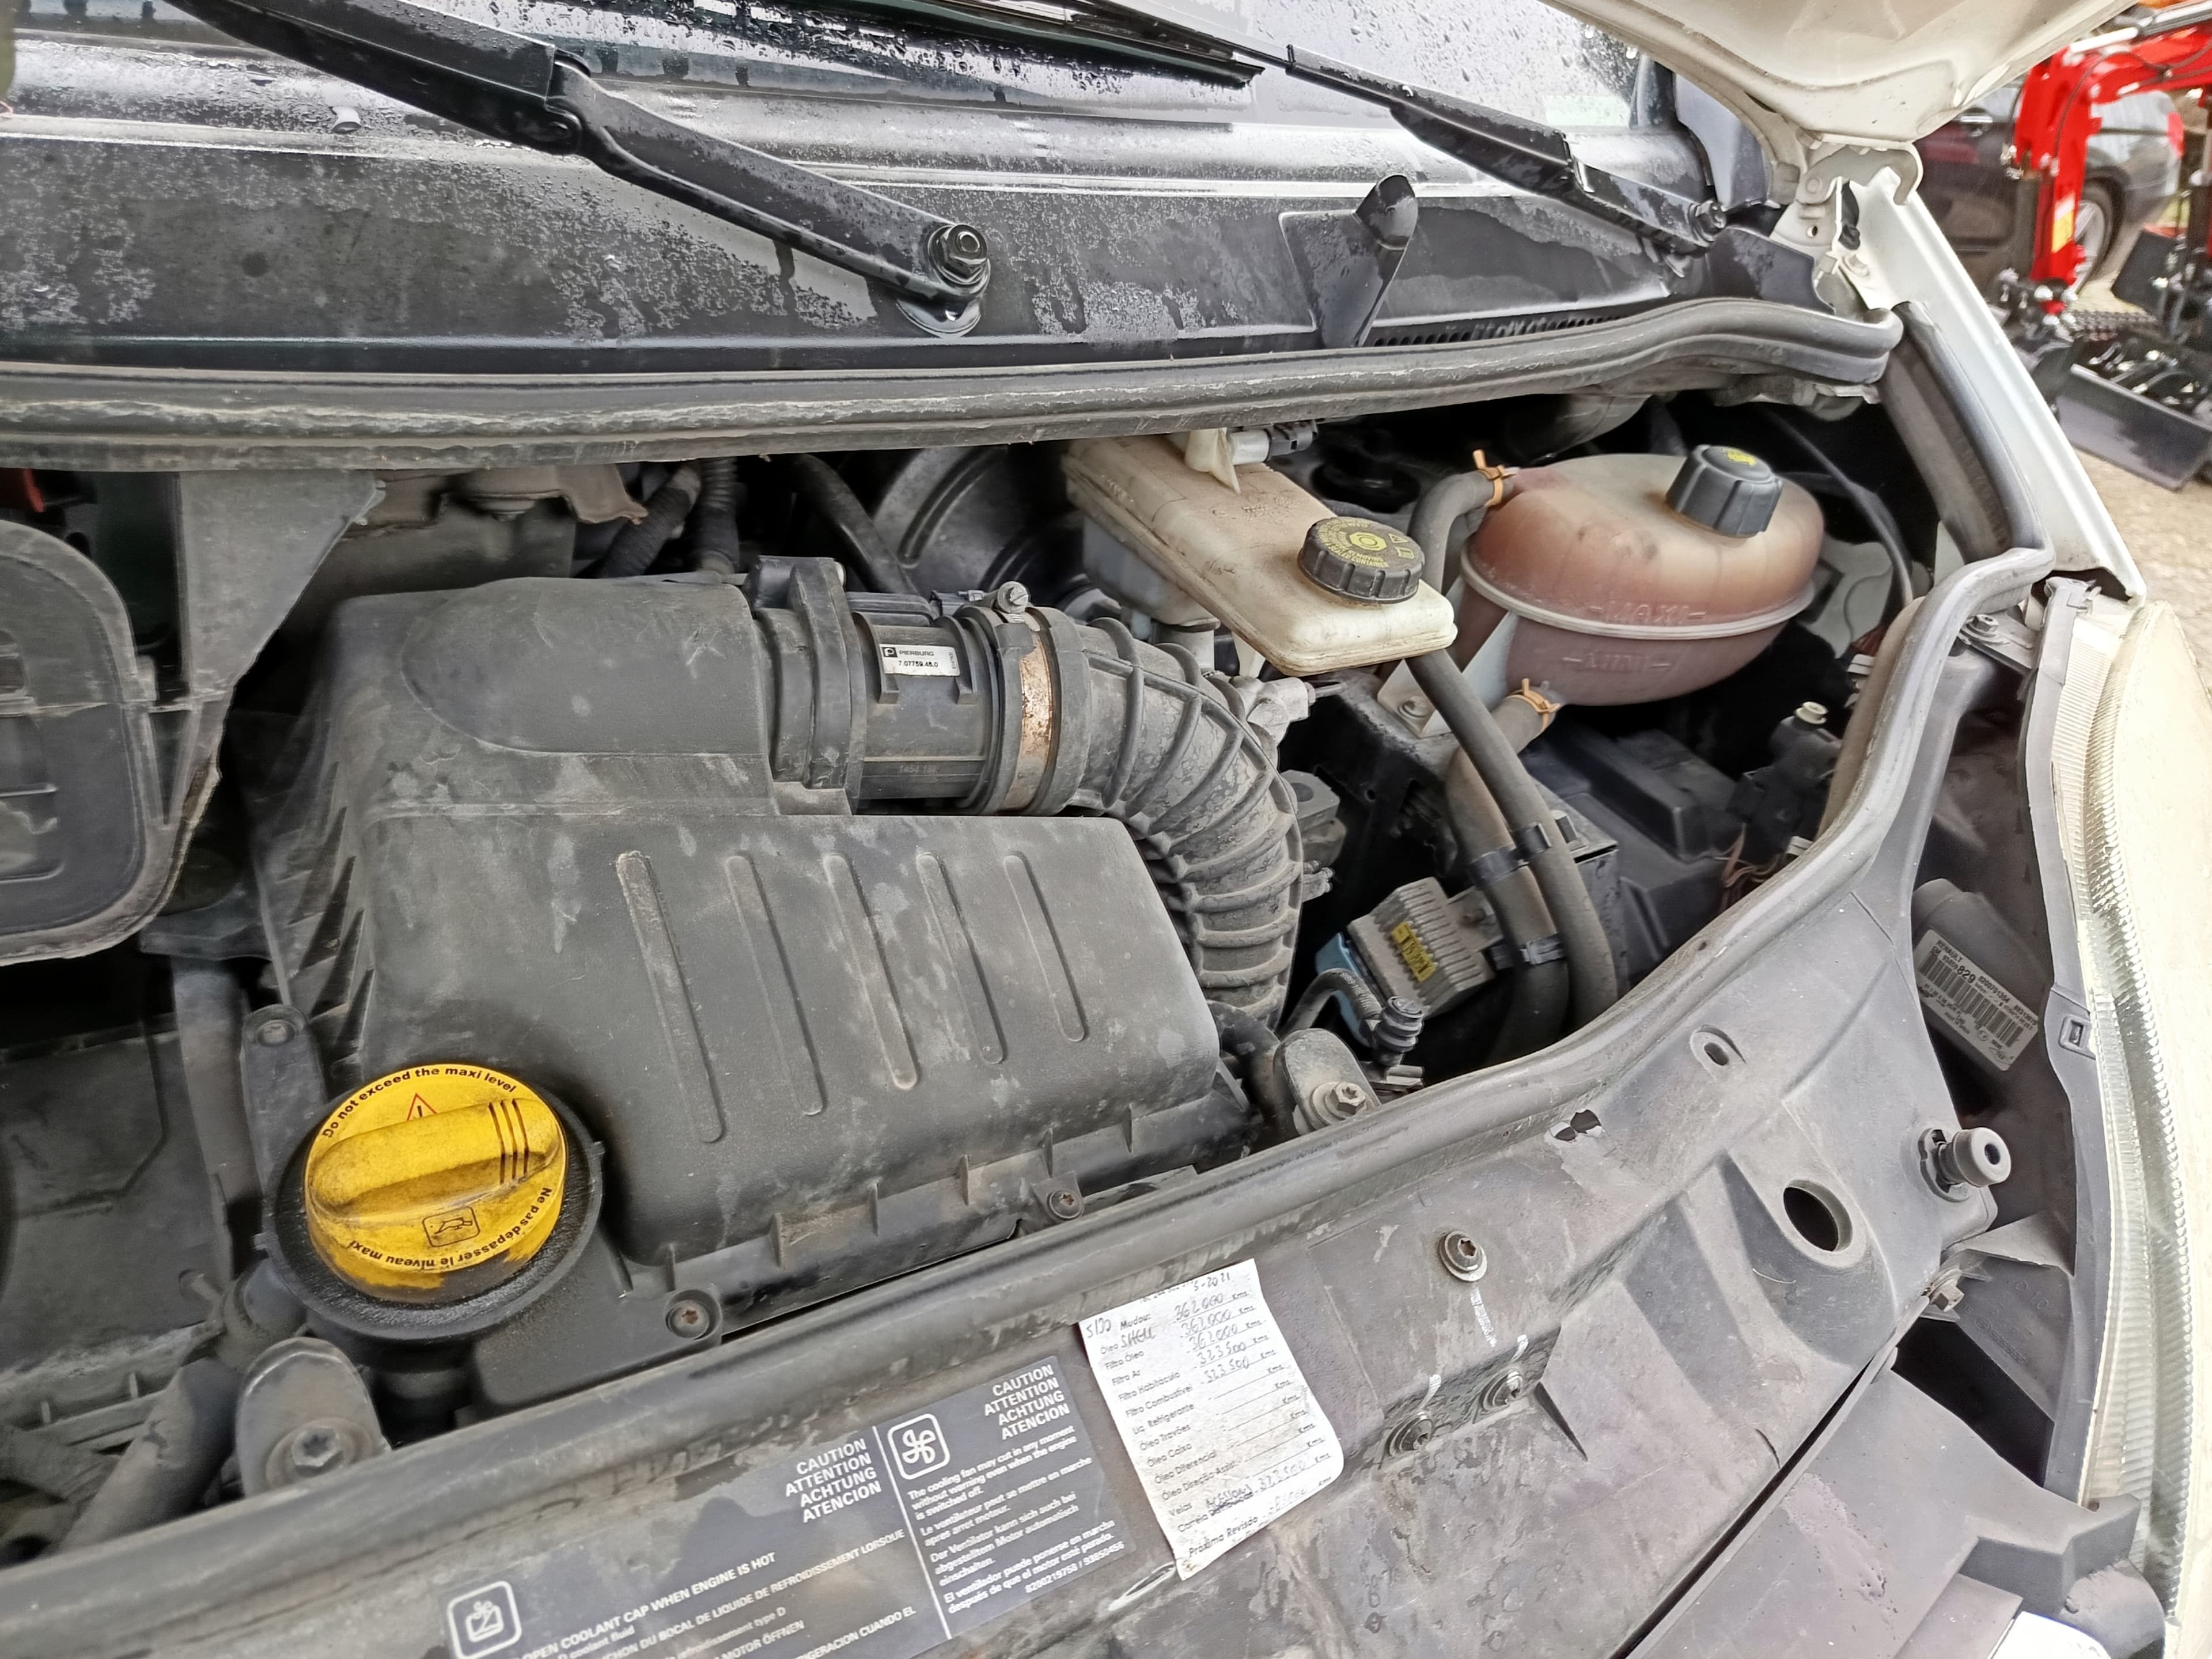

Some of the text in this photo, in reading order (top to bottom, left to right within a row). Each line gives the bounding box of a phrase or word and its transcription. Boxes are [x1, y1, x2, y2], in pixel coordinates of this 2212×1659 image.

[1936, 940, 1963, 963] RENAULT
[1957, 965, 1976, 983] 829
[322, 1068, 516, 1138] Do not exceed the maxi level
[537, 1187, 552, 1203] Ne
[520, 1205, 539, 1225] pas
[350, 1240, 382, 1260] maxi
[386, 1255, 435, 1271] niveau
[441, 1257, 454, 1267] le
[1101, 1343, 1118, 1354] Óleo
[1105, 1351, 1144, 1369] Filtro Óleo
[993, 1365, 1054, 1396] CAUTION
[1112, 1375, 1130, 1384] Filtro
[1118, 1372, 1180, 1400] Filtro Habitáculo
[984, 1377, 1059, 1416] ATTENTION
[999, 1391, 1065, 1426] ACHTUNG
[1126, 1387, 1192, 1416] Filtro Combustível
[1002, 1403, 1070, 1440] ATENCION
[1147, 1404, 1194, 1427] Refrigerante
[1140, 1425, 1191, 1450] Óleo Travões
[797, 1438, 866, 1474] CAUTION
[907, 1426, 1075, 1499] The cooling fan may cut in any moment
[1147, 1444, 1192, 1467] Óleo Caixa
[1155, 1449, 1217, 1484] Óleo Diferencial
[786, 1452, 872, 1497] ATTENTION
[801, 1467, 877, 1507] ACHTUNG
[912, 1436, 1077, 1510] without warning even when the engine
[804, 1481, 881, 1522] ATENCION
[915, 1512, 925, 1520] is
[926, 1492, 967, 1516] switched
[920, 1457, 1092, 1536] Le ventilateur peut se mettre en marche
[1162, 1488, 1182, 1501] Óleo
[1169, 1503, 1192, 1516] Velas
[930, 1491, 1077, 1562] Der Ventilator kann sich auch bei
[995, 1530, 1023, 1547] Motor
[1025, 1505, 1079, 1533] automatisch
[1178, 1514, 1209, 1532] Correia
[1226, 1517, 1257, 1537] Revisão
[944, 1520, 1115, 1603] El ventilador puede ponerse en marcha
[560, 1616, 620, 1649] COOLANT
[623, 1605, 649, 1623] CAP
[650, 1588, 691, 1611] WHEN
[691, 1569, 737, 1595] ENGINE
[738, 1563, 750, 1576] IS
[751, 1552, 776, 1571] HOT
[639, 1529, 905, 1649] DU BOCAL DE LIQUIDE DE REFROIDISSEMENT LORSQUE
[948, 1591, 988, 1613] después
[989, 1585, 1002, 1594] de
[1002, 1575, 1021, 1588] que
[1022, 1569, 1032, 1579] el
[1032, 1557, 1060, 1574] motor
[753, 1613, 776, 1626] type
[776, 1607, 786, 1616] D
[859, 1612, 902, 1637] CUANDO
[902, 1606, 917, 1617] EL
[570, 1637, 609, 1658] coolant
[611, 1625, 635, 1642] fluid
[721, 1620, 805, 1659] MOTOR ÖFFNEN
